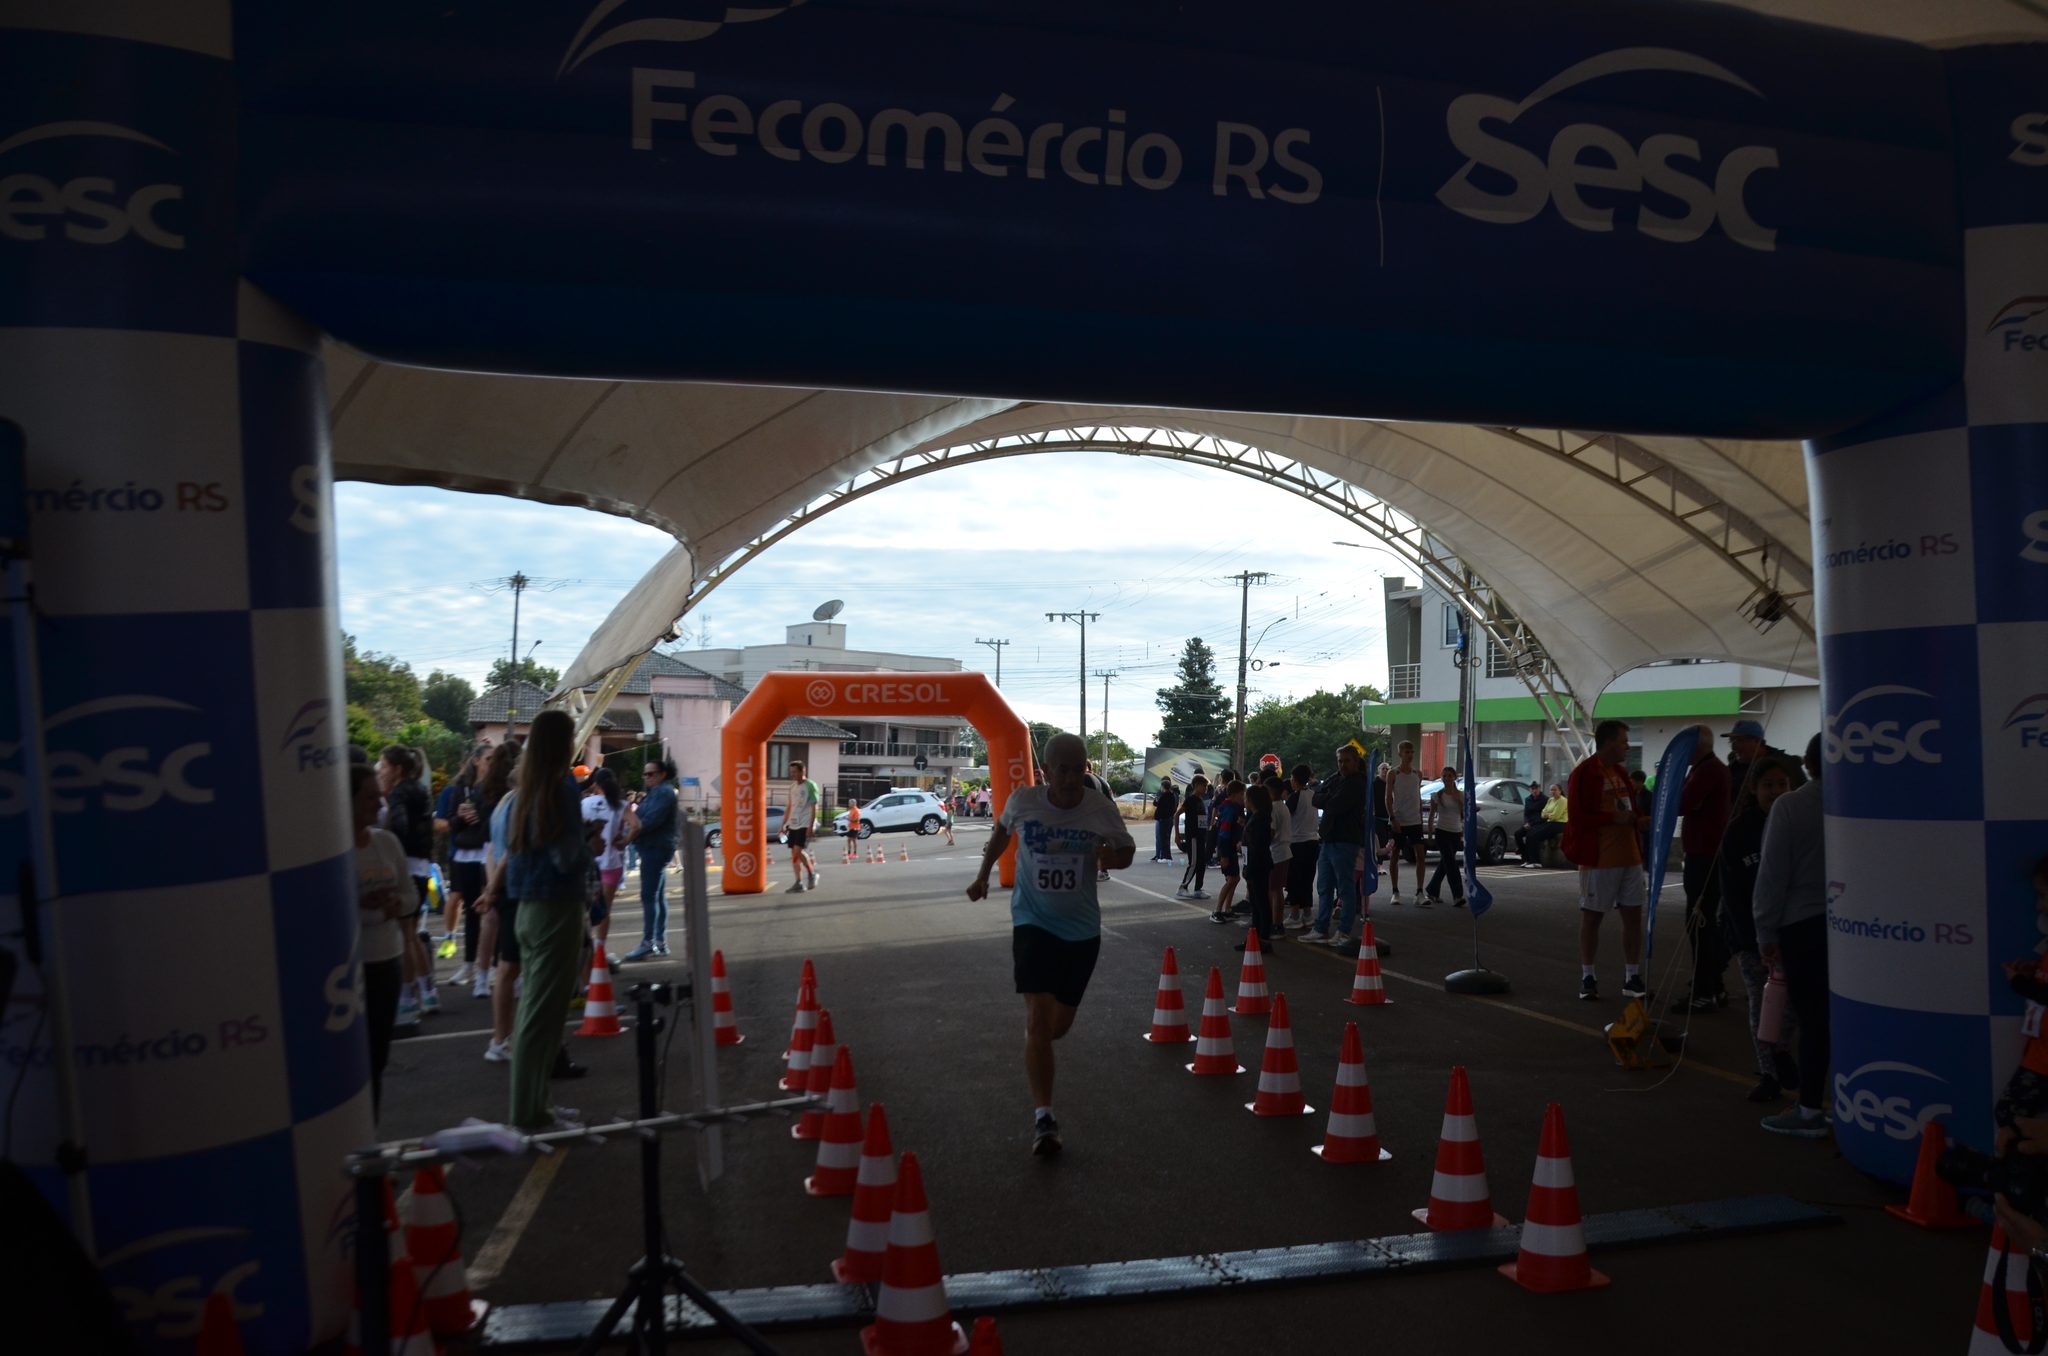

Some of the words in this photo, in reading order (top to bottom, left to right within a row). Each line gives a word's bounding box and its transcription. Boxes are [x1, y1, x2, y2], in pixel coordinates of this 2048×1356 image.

[631, 67, 1183, 191] Fecomércio
[1212, 120, 1324, 205] RS
[177, 482, 229, 512] RS
[1920, 533, 1959, 558] RS
[844, 683, 950, 704] CRESOL
[734, 755, 755, 846] CRESOL
[1038, 869, 1077, 890] 503
[1934, 923, 1974, 946] RS
[219, 1014, 269, 1049] RS
